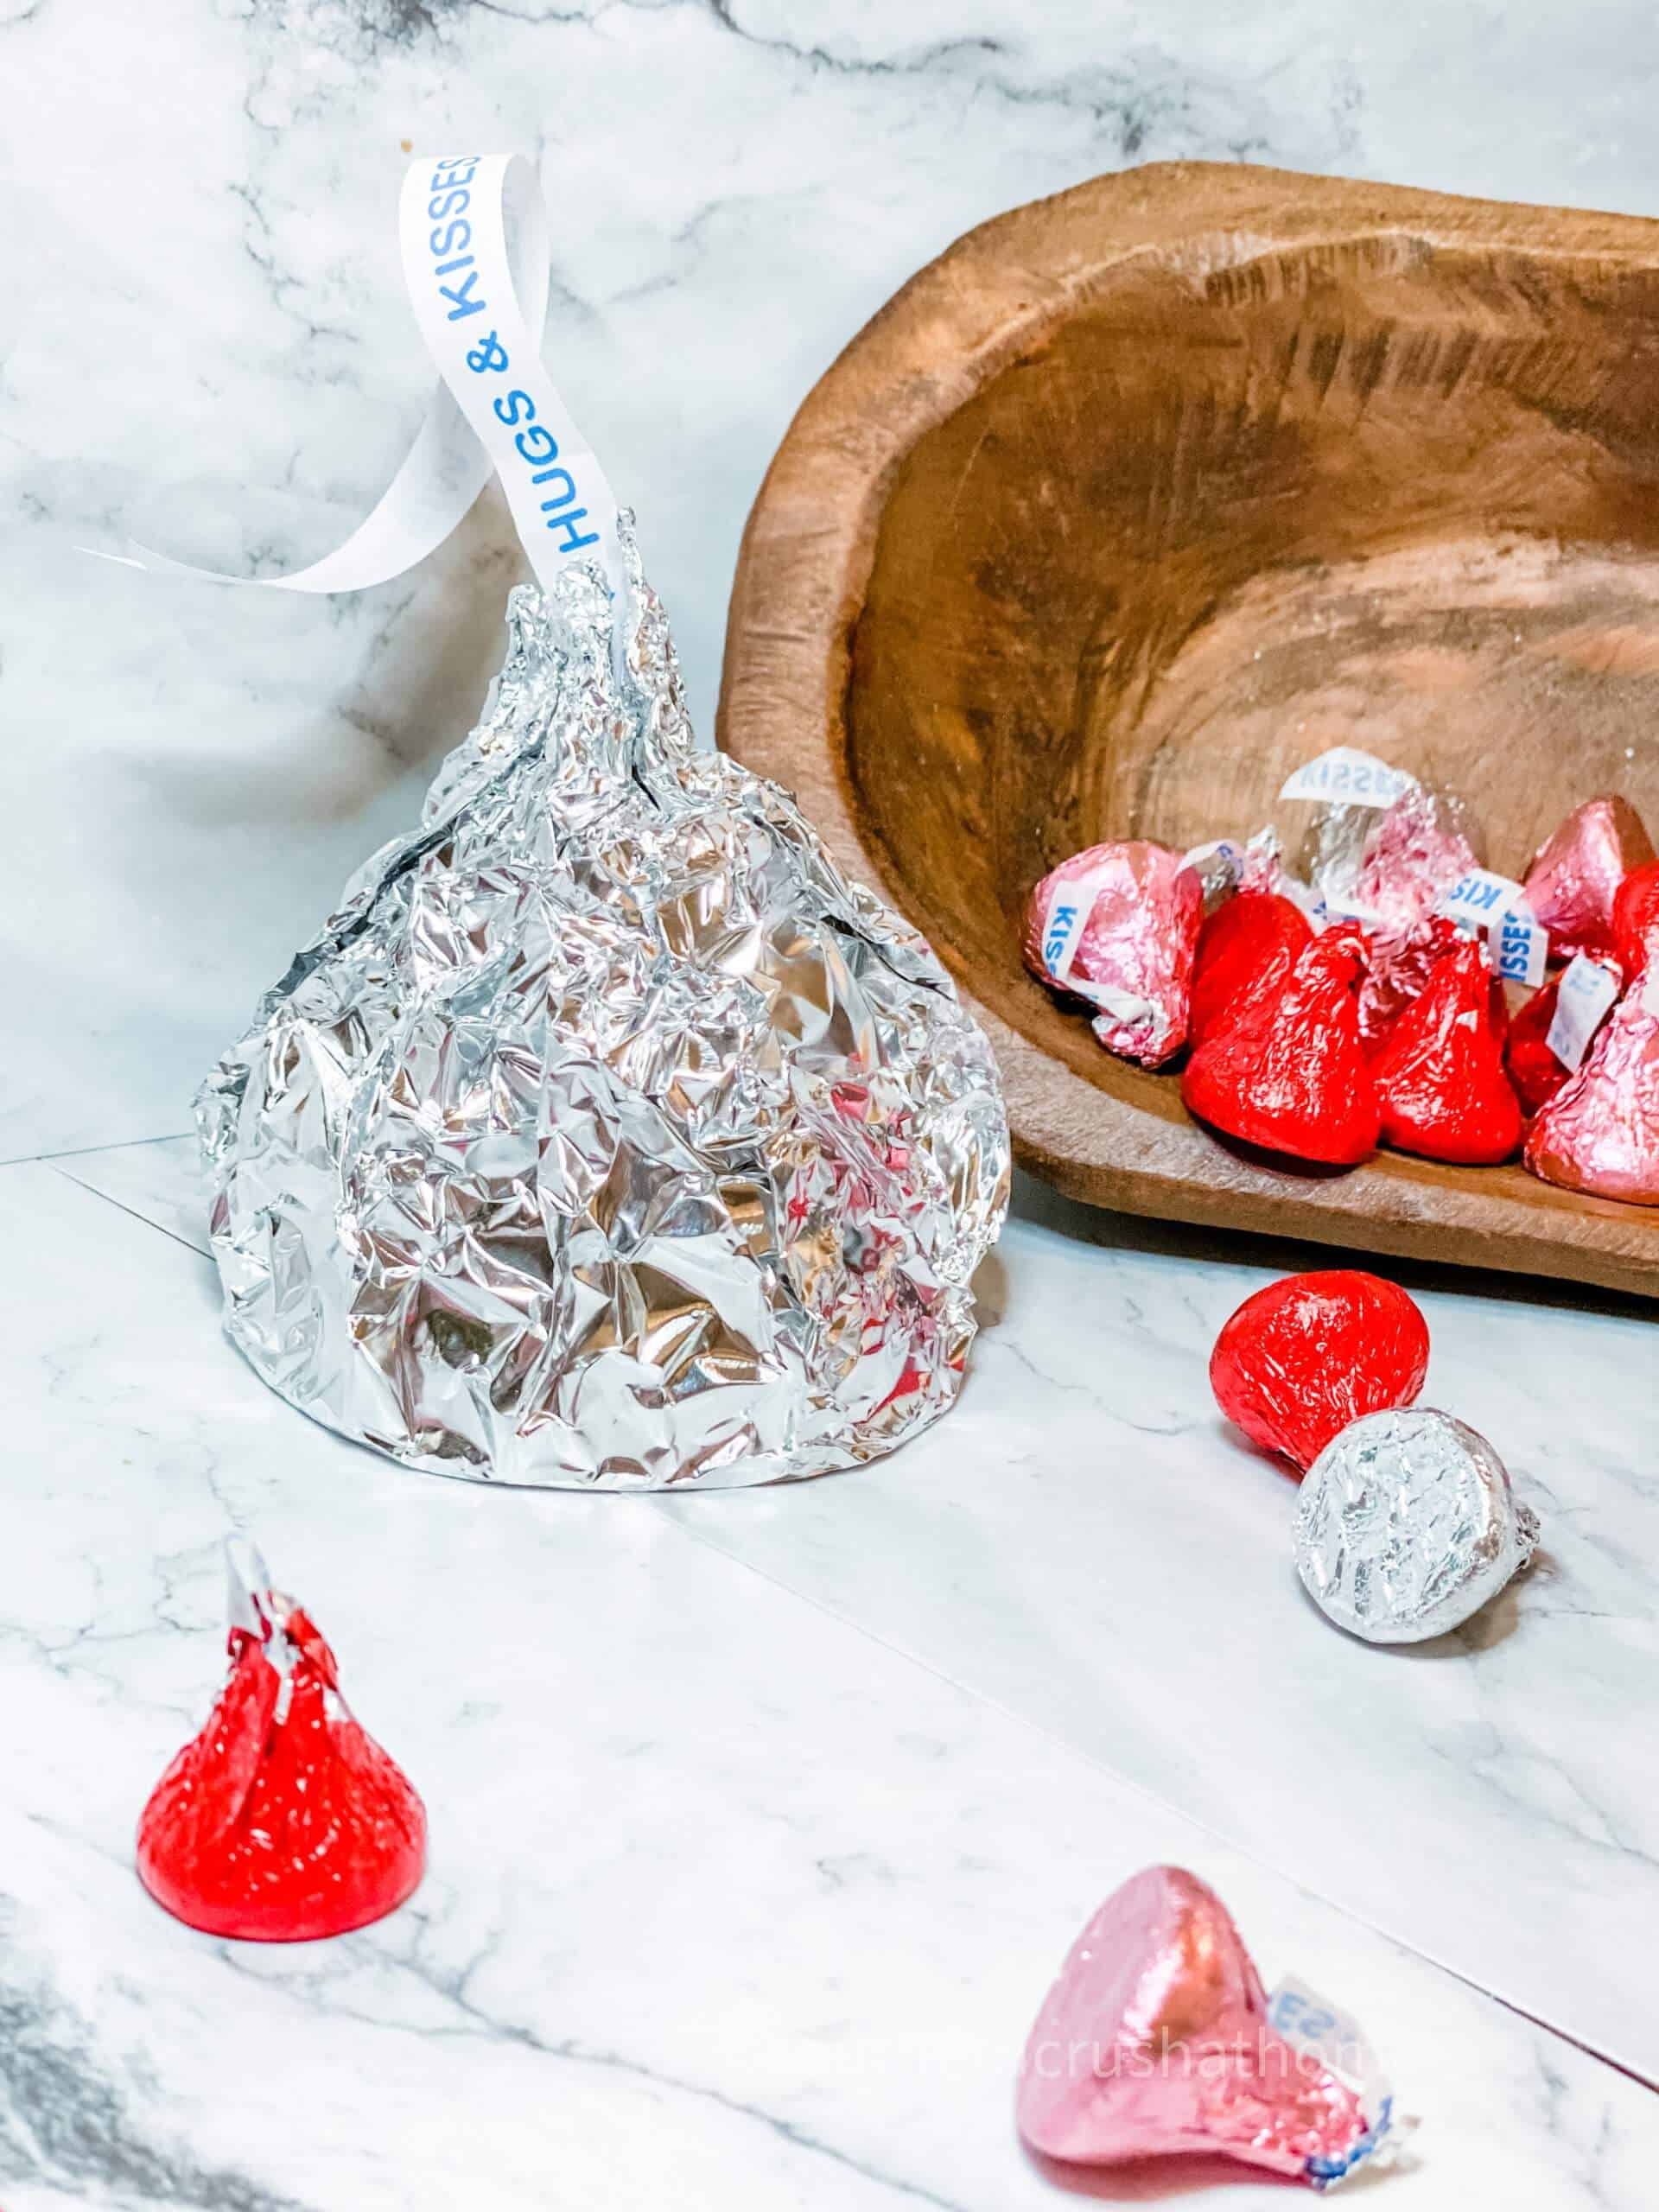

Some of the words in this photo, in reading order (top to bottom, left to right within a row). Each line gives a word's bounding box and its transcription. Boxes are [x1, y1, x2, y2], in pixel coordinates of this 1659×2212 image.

[428, 156, 486, 321] KISSES
[466, 330, 510, 373] &
[493, 389, 600, 553] HUGS
